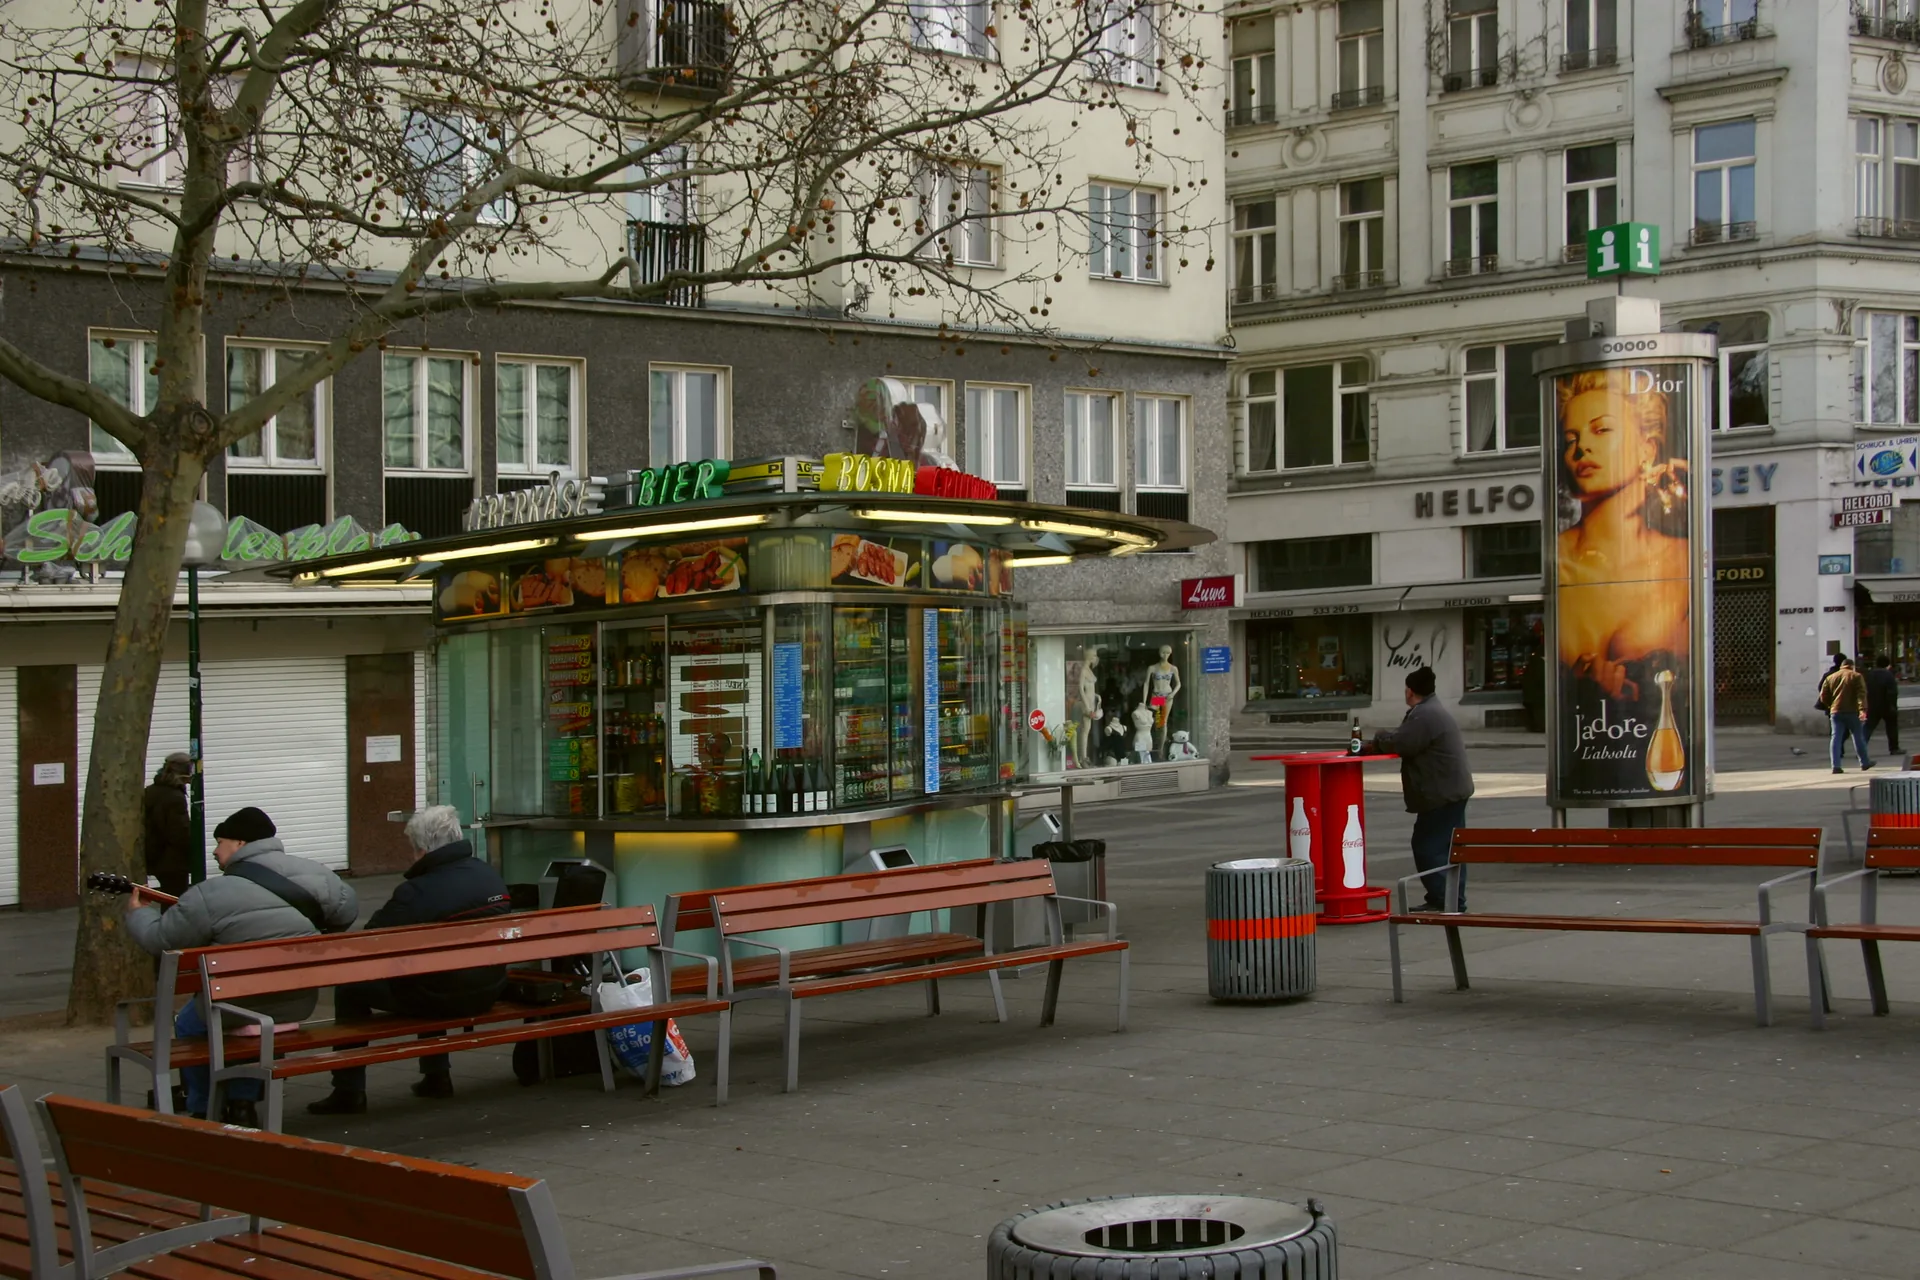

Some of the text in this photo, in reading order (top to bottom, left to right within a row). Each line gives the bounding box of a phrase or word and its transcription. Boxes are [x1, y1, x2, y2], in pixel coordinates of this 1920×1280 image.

[1628, 368, 1684, 395] Dior
[1857, 441, 1886, 450] SCHMUCK
[1896, 436, 1917, 445] UHREN
[837, 455, 914, 494] BOSNA
[638, 461, 716, 506] BIER
[1415, 484, 1535, 518] HELFO
[1844, 494, 1891, 510] HELFORD
[1839, 511, 1878, 526] JERSEY
[1715, 567, 1764, 580] FORD
[1828, 564, 1840, 573] 19
[1188, 580, 1226, 602] Luwa
[1444, 597, 1491, 608] HELFORD
[1250, 605, 1359, 618] HELFORD 533 29 73
[1779, 607, 1814, 615] HELFORD
[1030, 714, 1045, 726] 50%
[1573, 699, 1648, 753] j'adore
[1581, 744, 1637, 760] L'absolu
